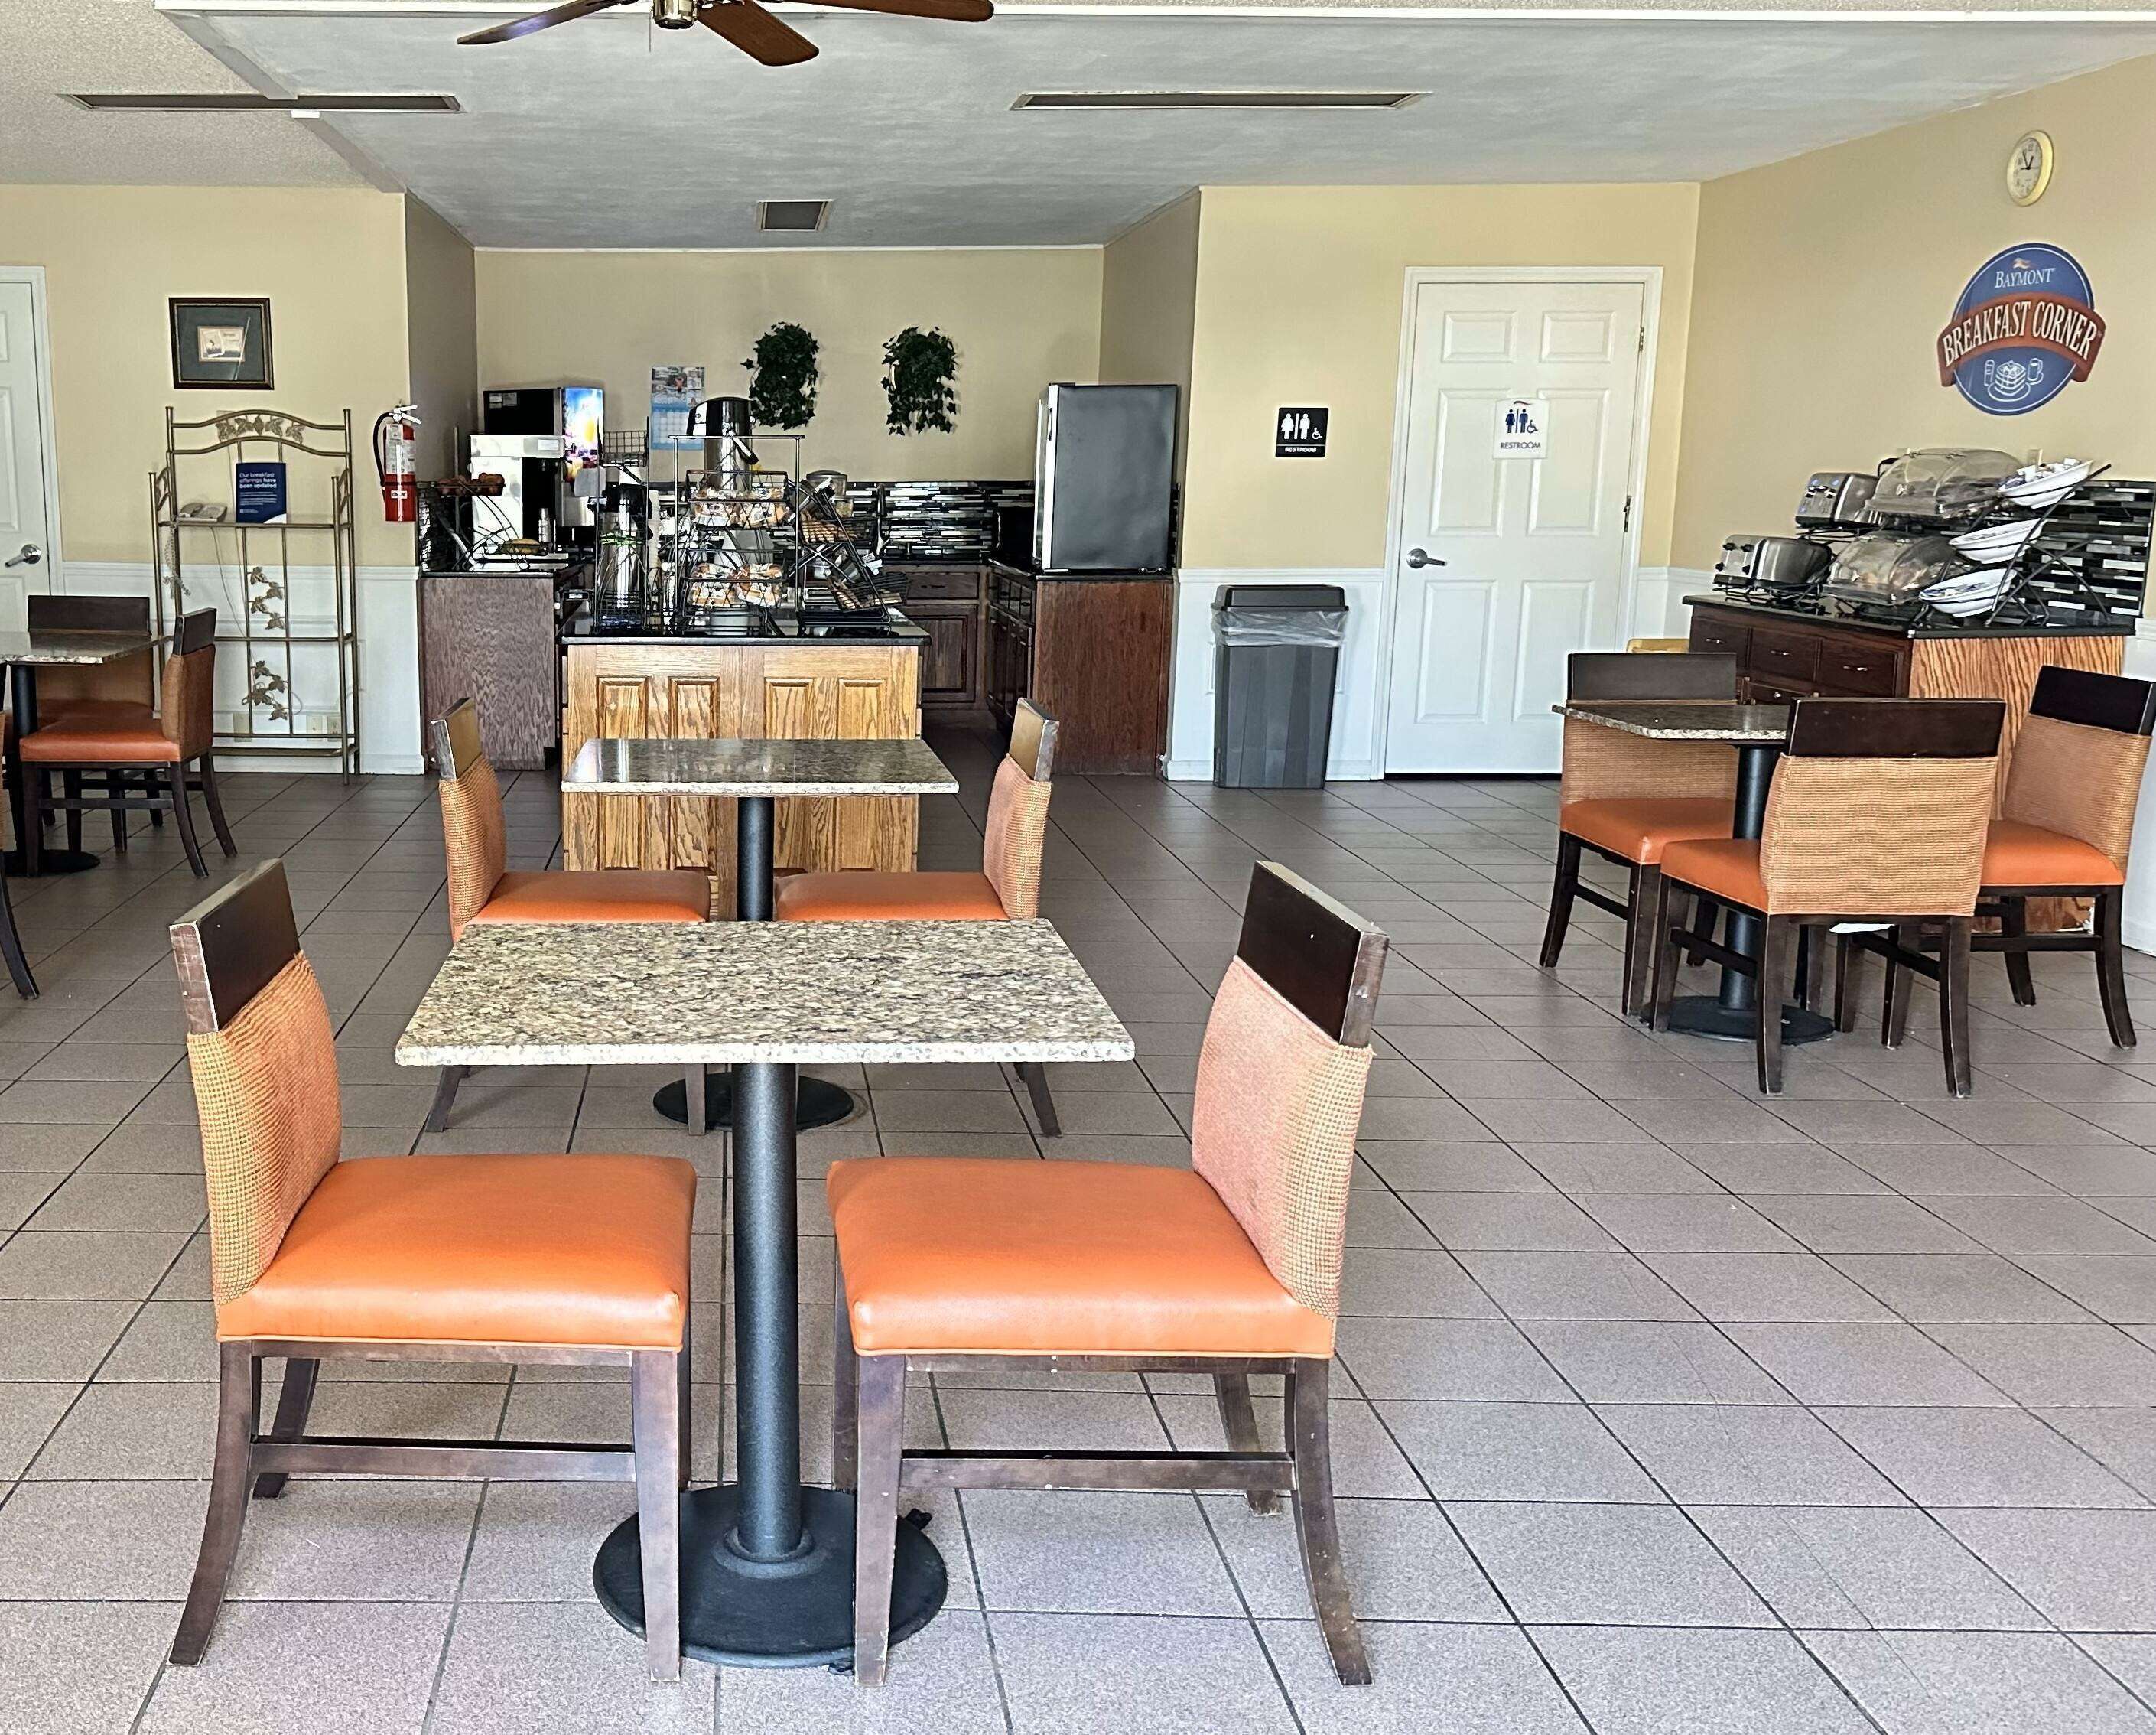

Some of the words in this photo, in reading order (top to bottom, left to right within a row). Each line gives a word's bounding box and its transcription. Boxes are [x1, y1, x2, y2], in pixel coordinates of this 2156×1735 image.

[1995, 268, 2055, 288] BAYMONT
[1943, 301, 2031, 367] BREAKFAST
[2032, 301, 2098, 360] CORNER
